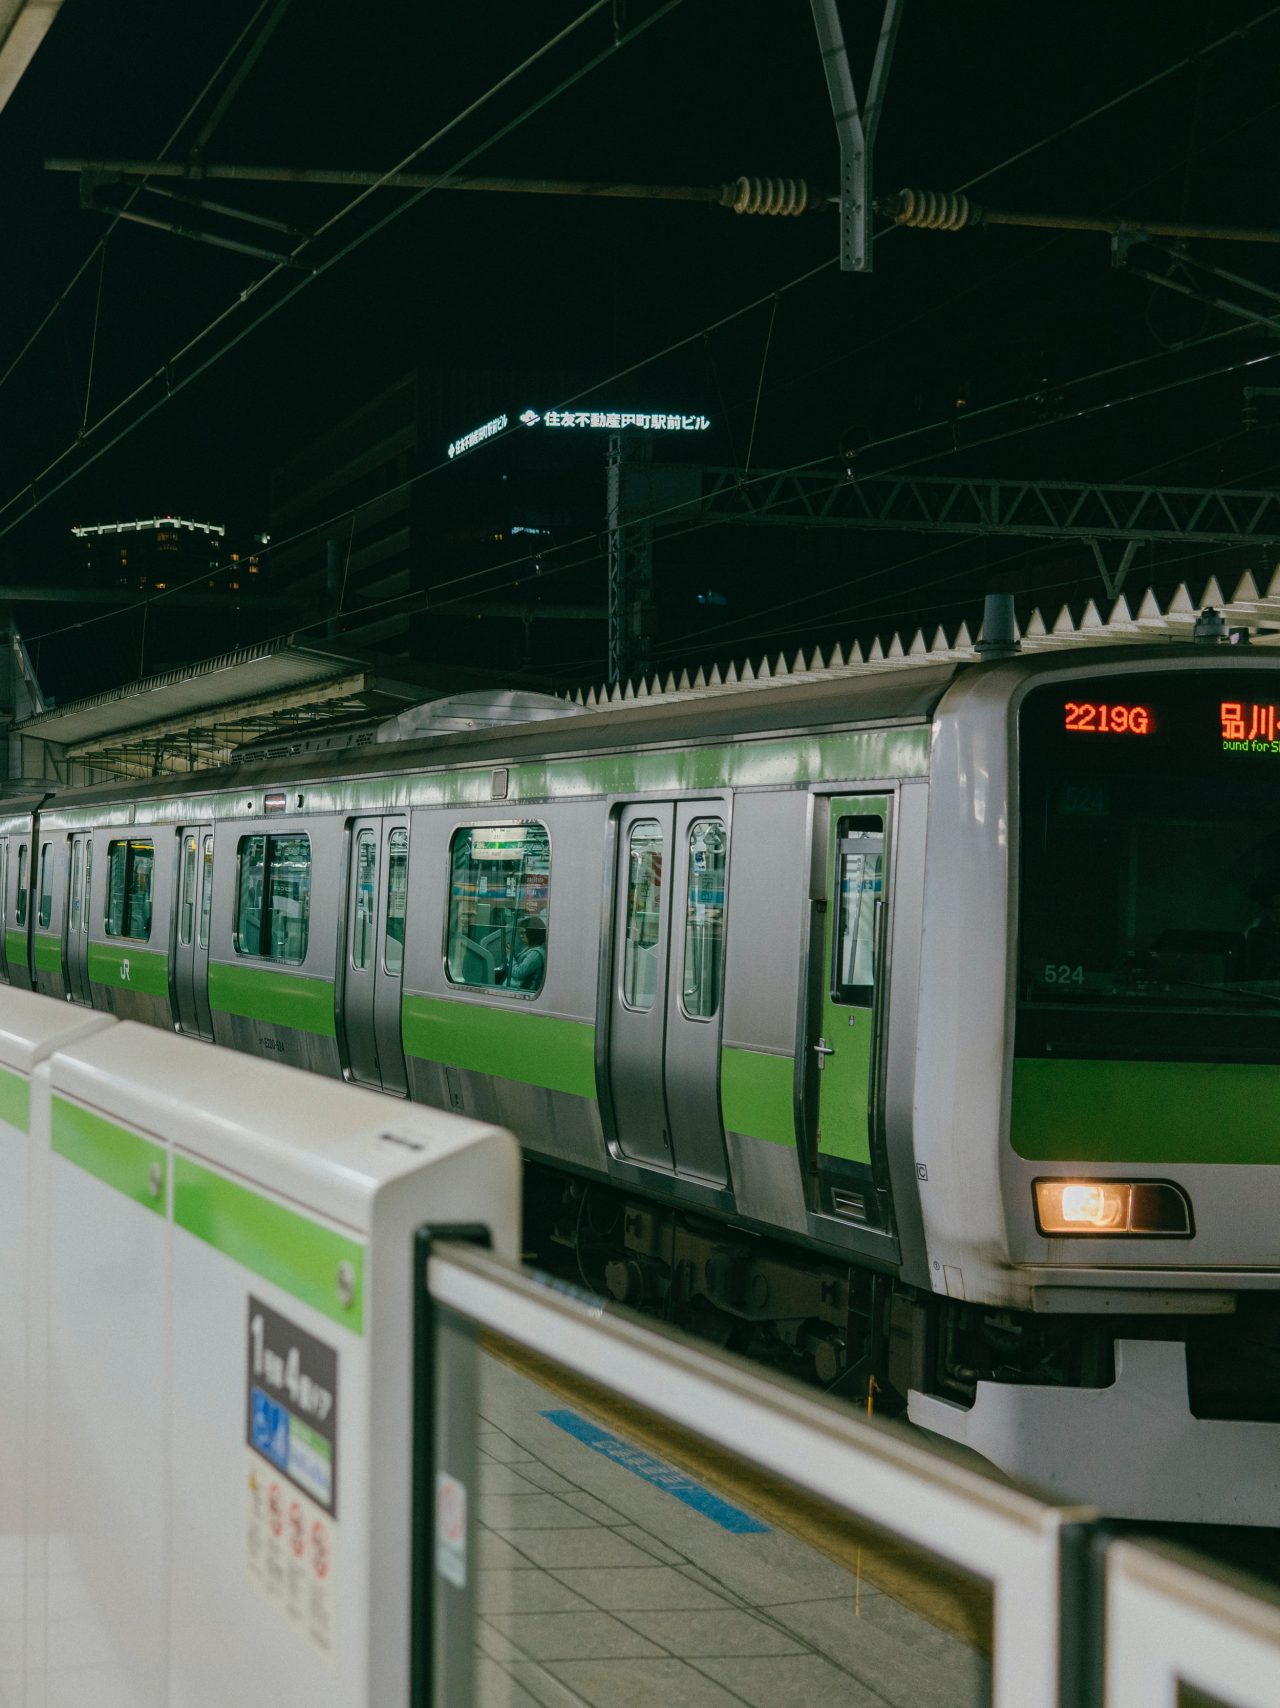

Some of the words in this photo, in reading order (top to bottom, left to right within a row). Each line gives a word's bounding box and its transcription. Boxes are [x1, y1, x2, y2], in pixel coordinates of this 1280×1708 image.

[543, 411, 710, 430] 住友不動産田町駅前ビル
[1064, 702, 1150, 735] 2219G
[1251, 740, 1270, 752] for
[1271, 740, 1280, 753] S
[119, 958, 131, 981] JR
[1043, 965, 1085, 985] 524
